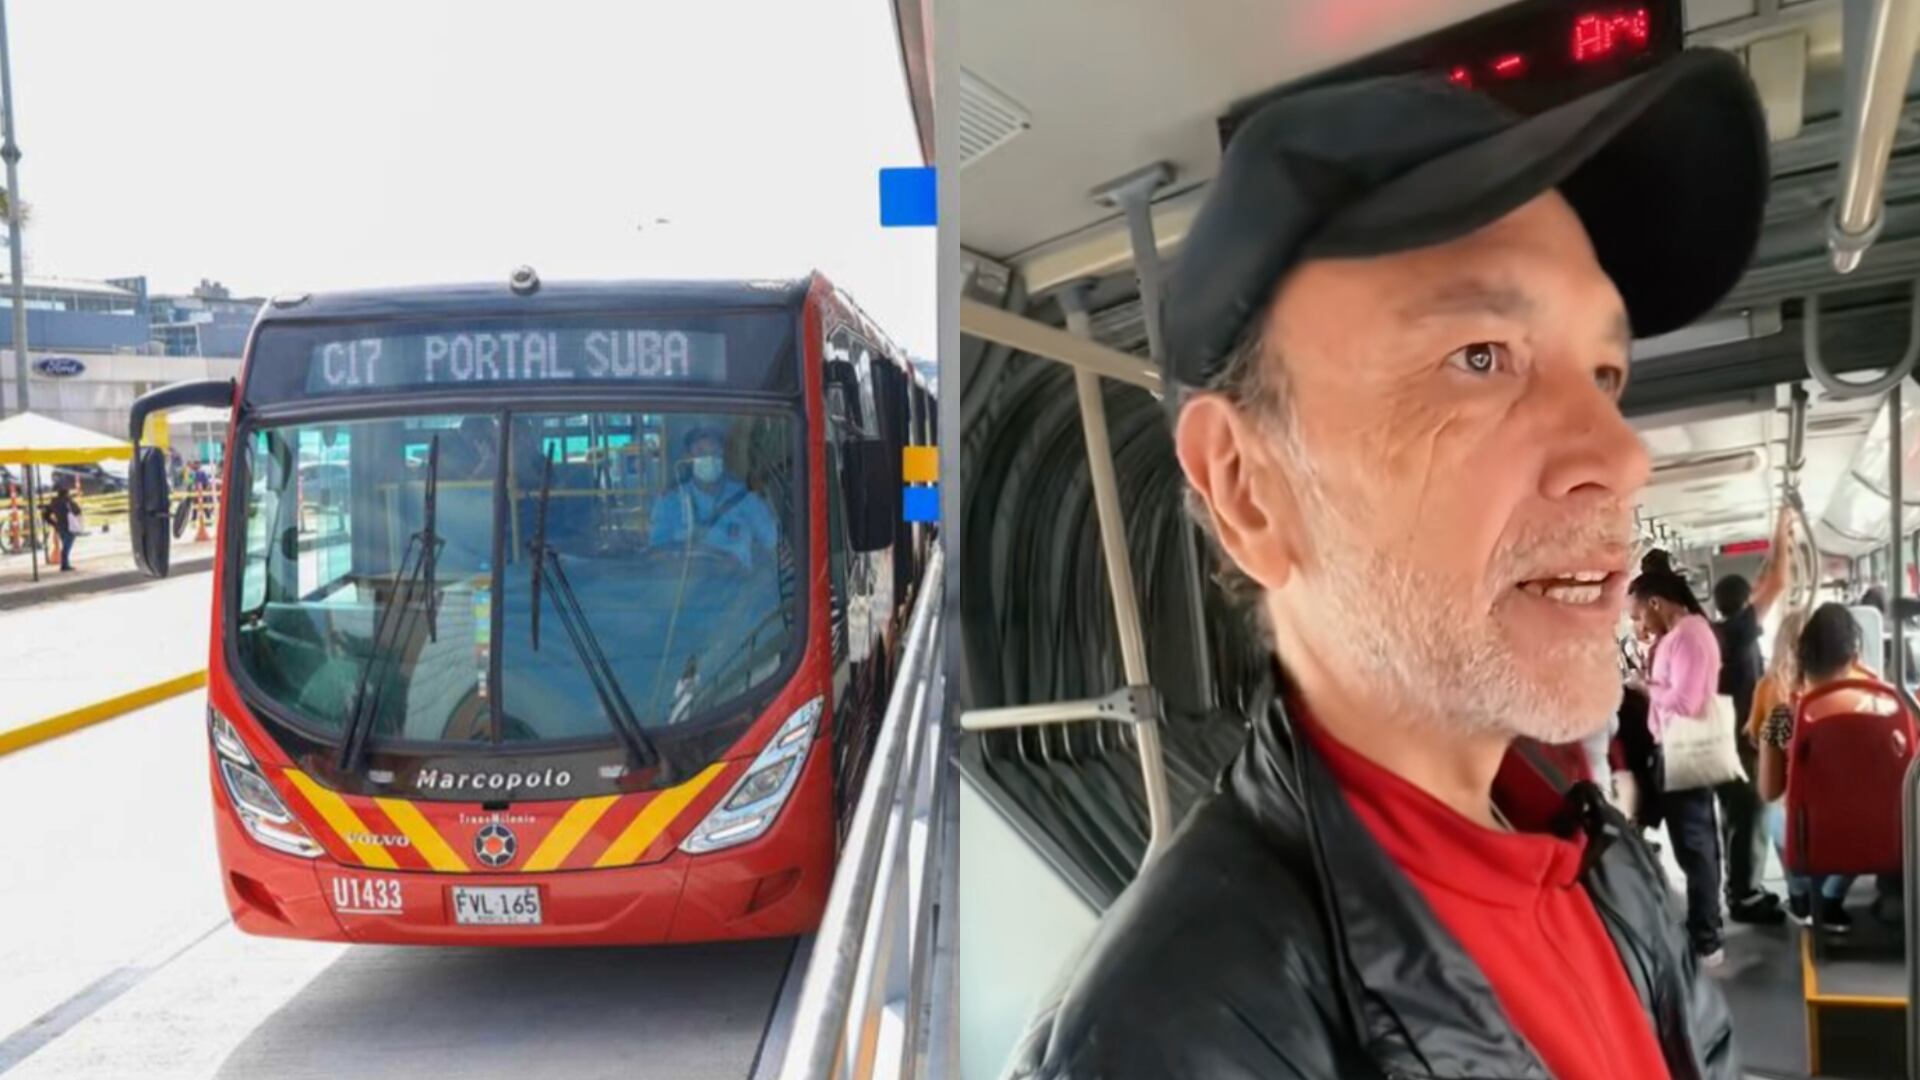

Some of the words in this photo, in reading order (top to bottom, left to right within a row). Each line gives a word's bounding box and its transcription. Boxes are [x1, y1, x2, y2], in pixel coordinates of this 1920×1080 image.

[46, 359, 77, 373] Ford
[323, 338, 382, 385] C17
[425, 332, 573, 382] PORTAL
[584, 330, 689, 378] SUBA
[416, 768, 571, 790] Marcopolo
[346, 832, 410, 847] VOLVO
[333, 878, 402, 908] U1433
